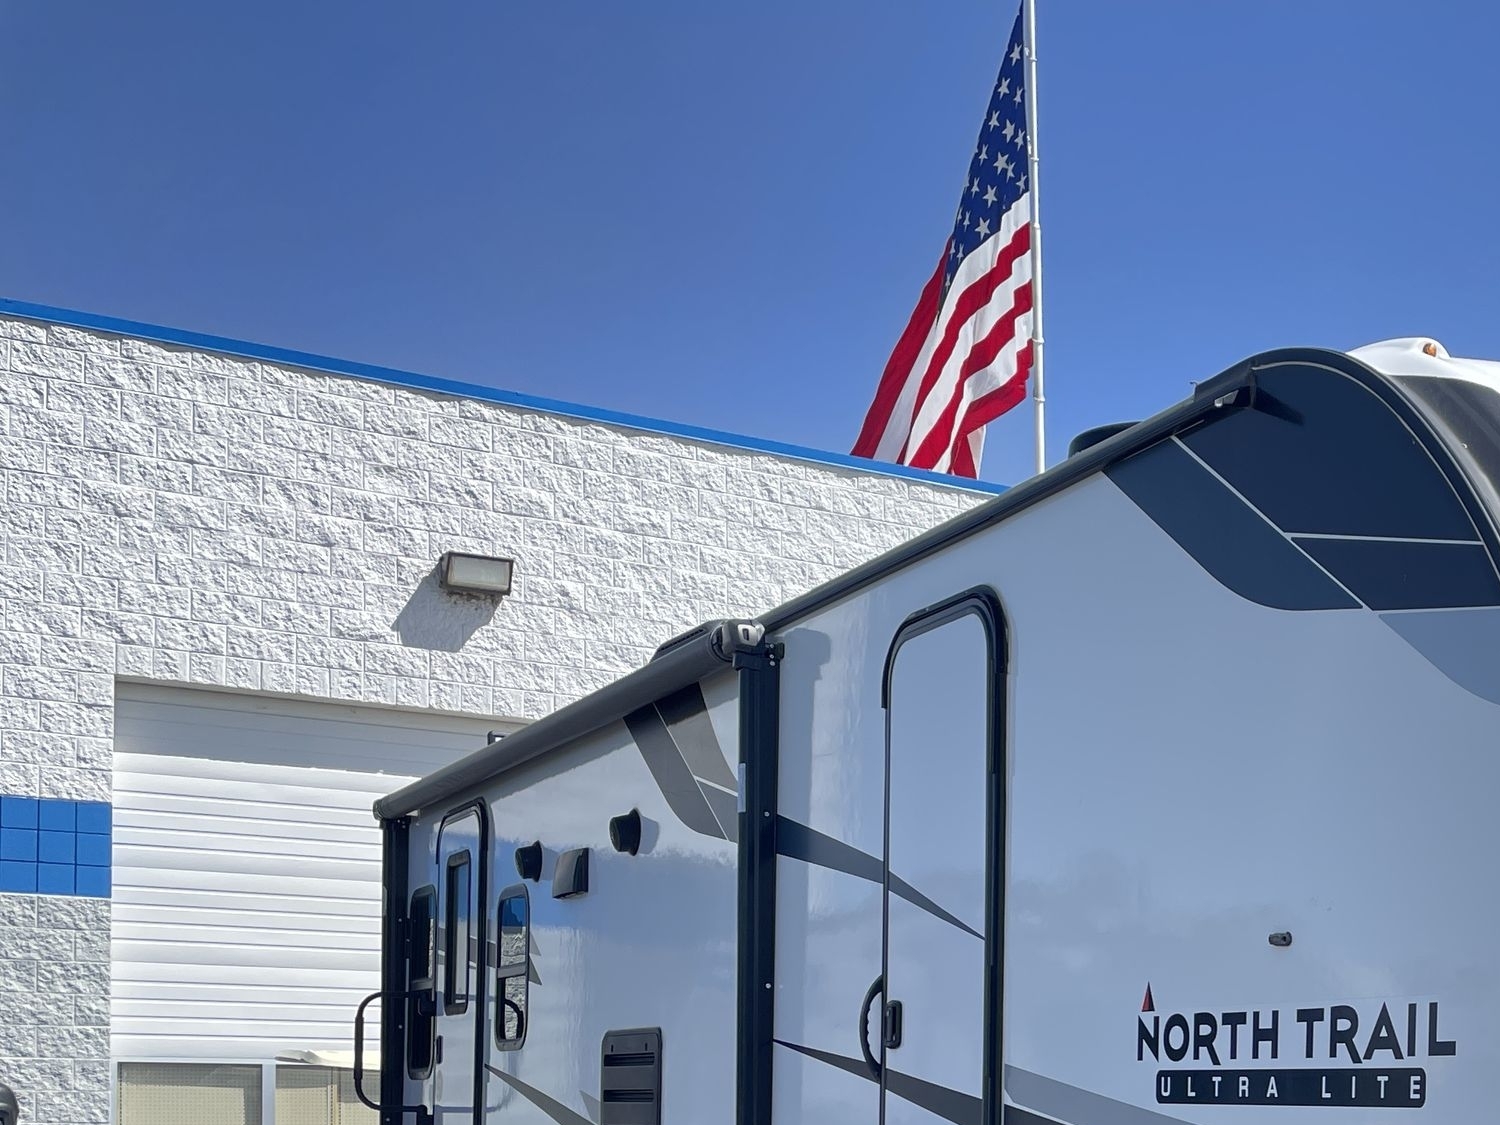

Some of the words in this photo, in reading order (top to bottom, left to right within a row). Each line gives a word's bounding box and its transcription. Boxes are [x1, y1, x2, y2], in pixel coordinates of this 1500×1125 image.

[1137, 1009, 1280, 1066] NORTH
[1296, 1001, 1457, 1064] TRAIL
[1160, 1076, 1279, 1099] ULTRA
[1321, 1075, 1422, 1100] LITE
